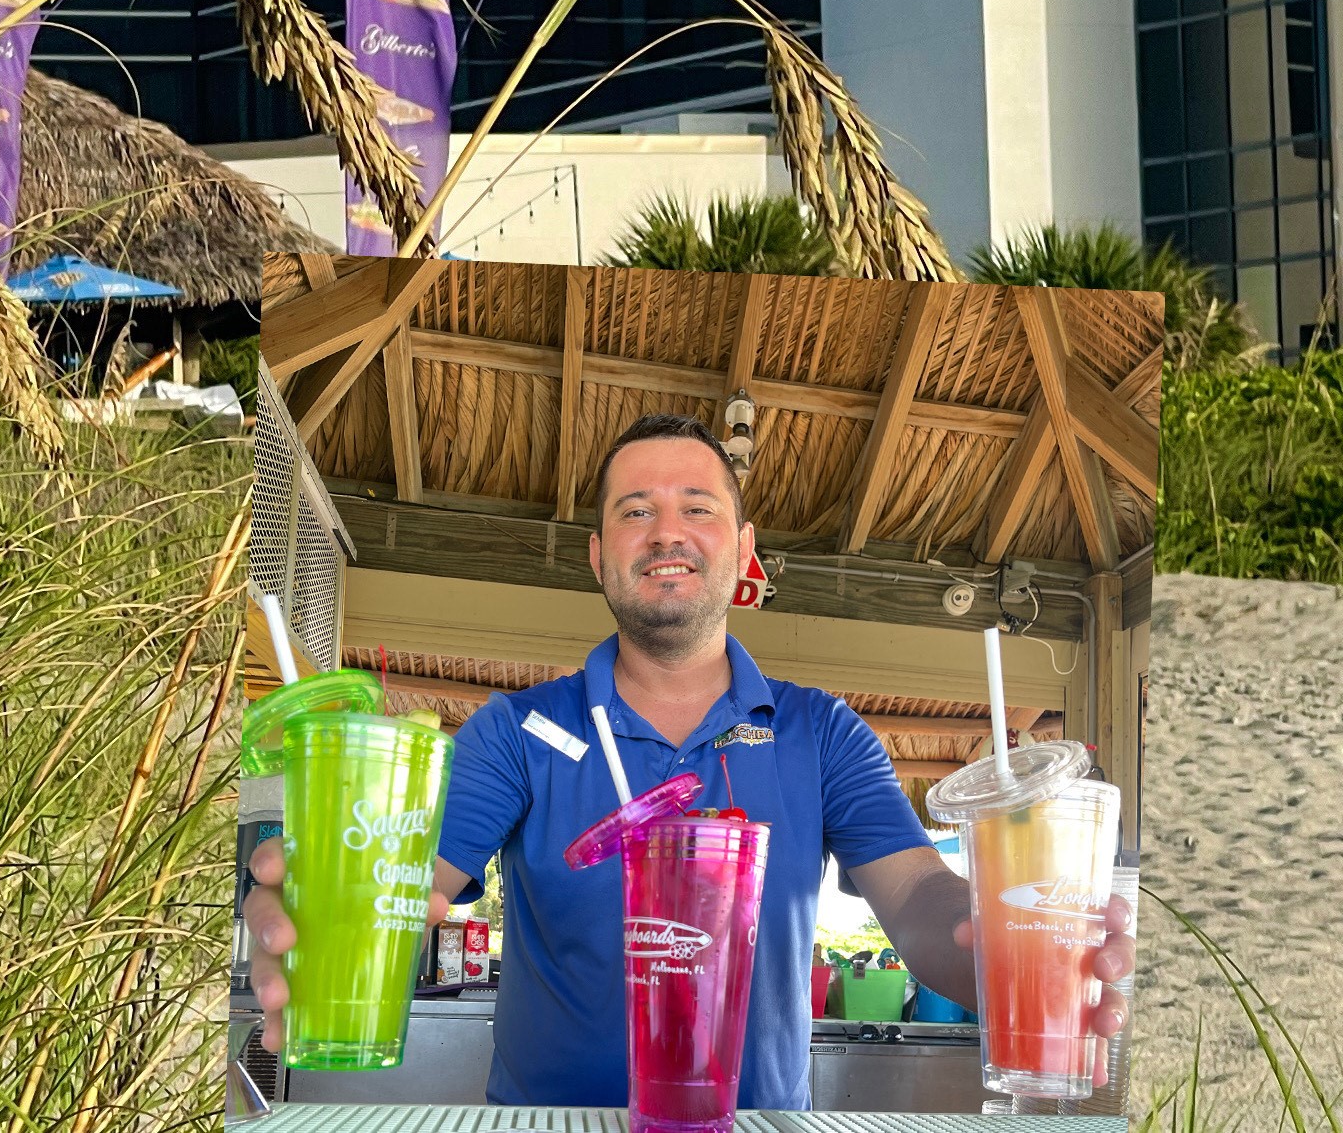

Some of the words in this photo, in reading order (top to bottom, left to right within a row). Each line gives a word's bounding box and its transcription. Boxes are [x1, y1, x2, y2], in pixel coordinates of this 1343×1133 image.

[343, 800, 429, 851] Sauza
[372, 858, 423, 888] Captain
[374, 918, 406, 931] AGED
[1065, 923, 1075, 932] FL
[694, 965, 706, 975] FL
[651, 975, 661, 986] FL
